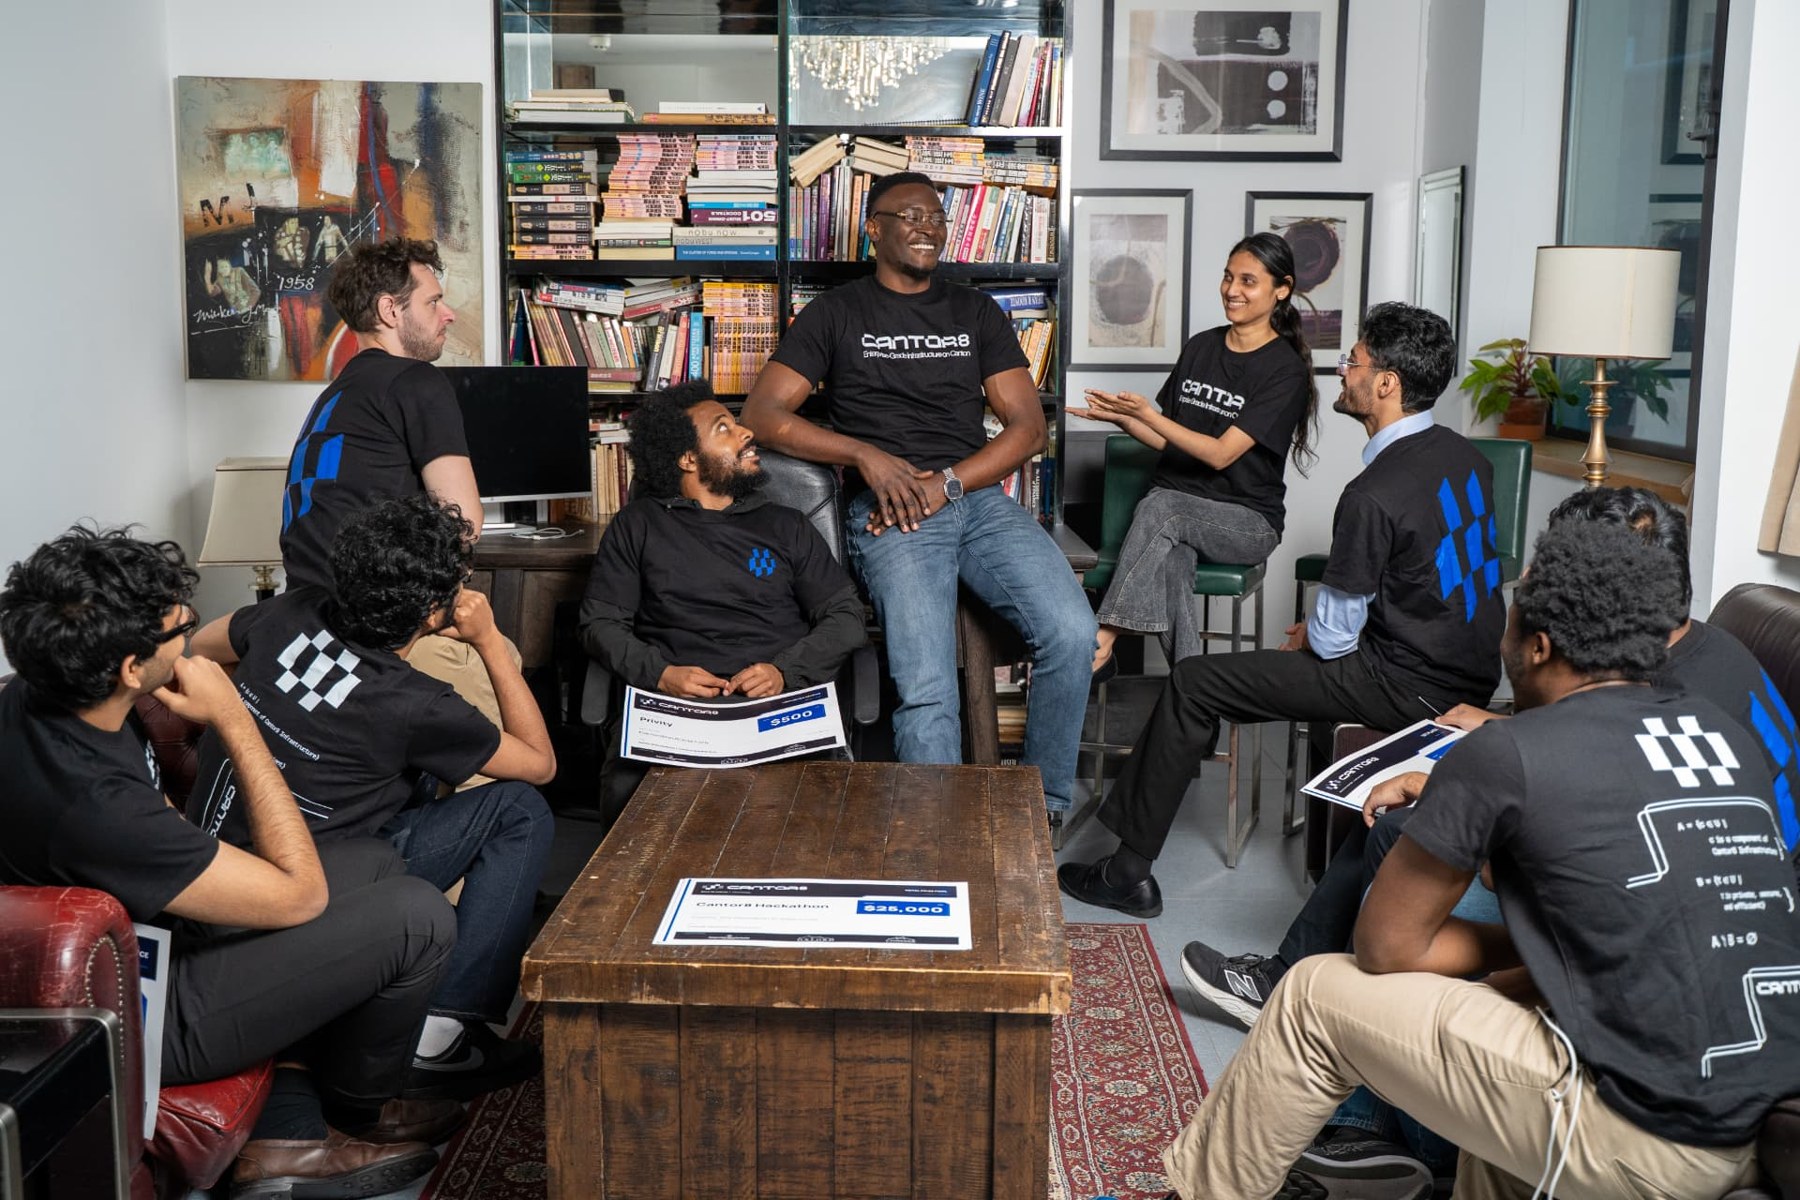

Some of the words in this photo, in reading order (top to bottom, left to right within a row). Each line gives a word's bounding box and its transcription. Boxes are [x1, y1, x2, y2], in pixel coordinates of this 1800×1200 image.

[742, 210, 776, 222] 501
[279, 276, 315, 292] 1958
[861, 333, 970, 350] CANTOR8
[658, 702, 719, 716] CANTOR8
[770, 709, 813, 727] $500
[727, 884, 808, 892] CANTOR8
[755, 902, 830, 910] Hackathon
[863, 904, 944, 914] $25,000
